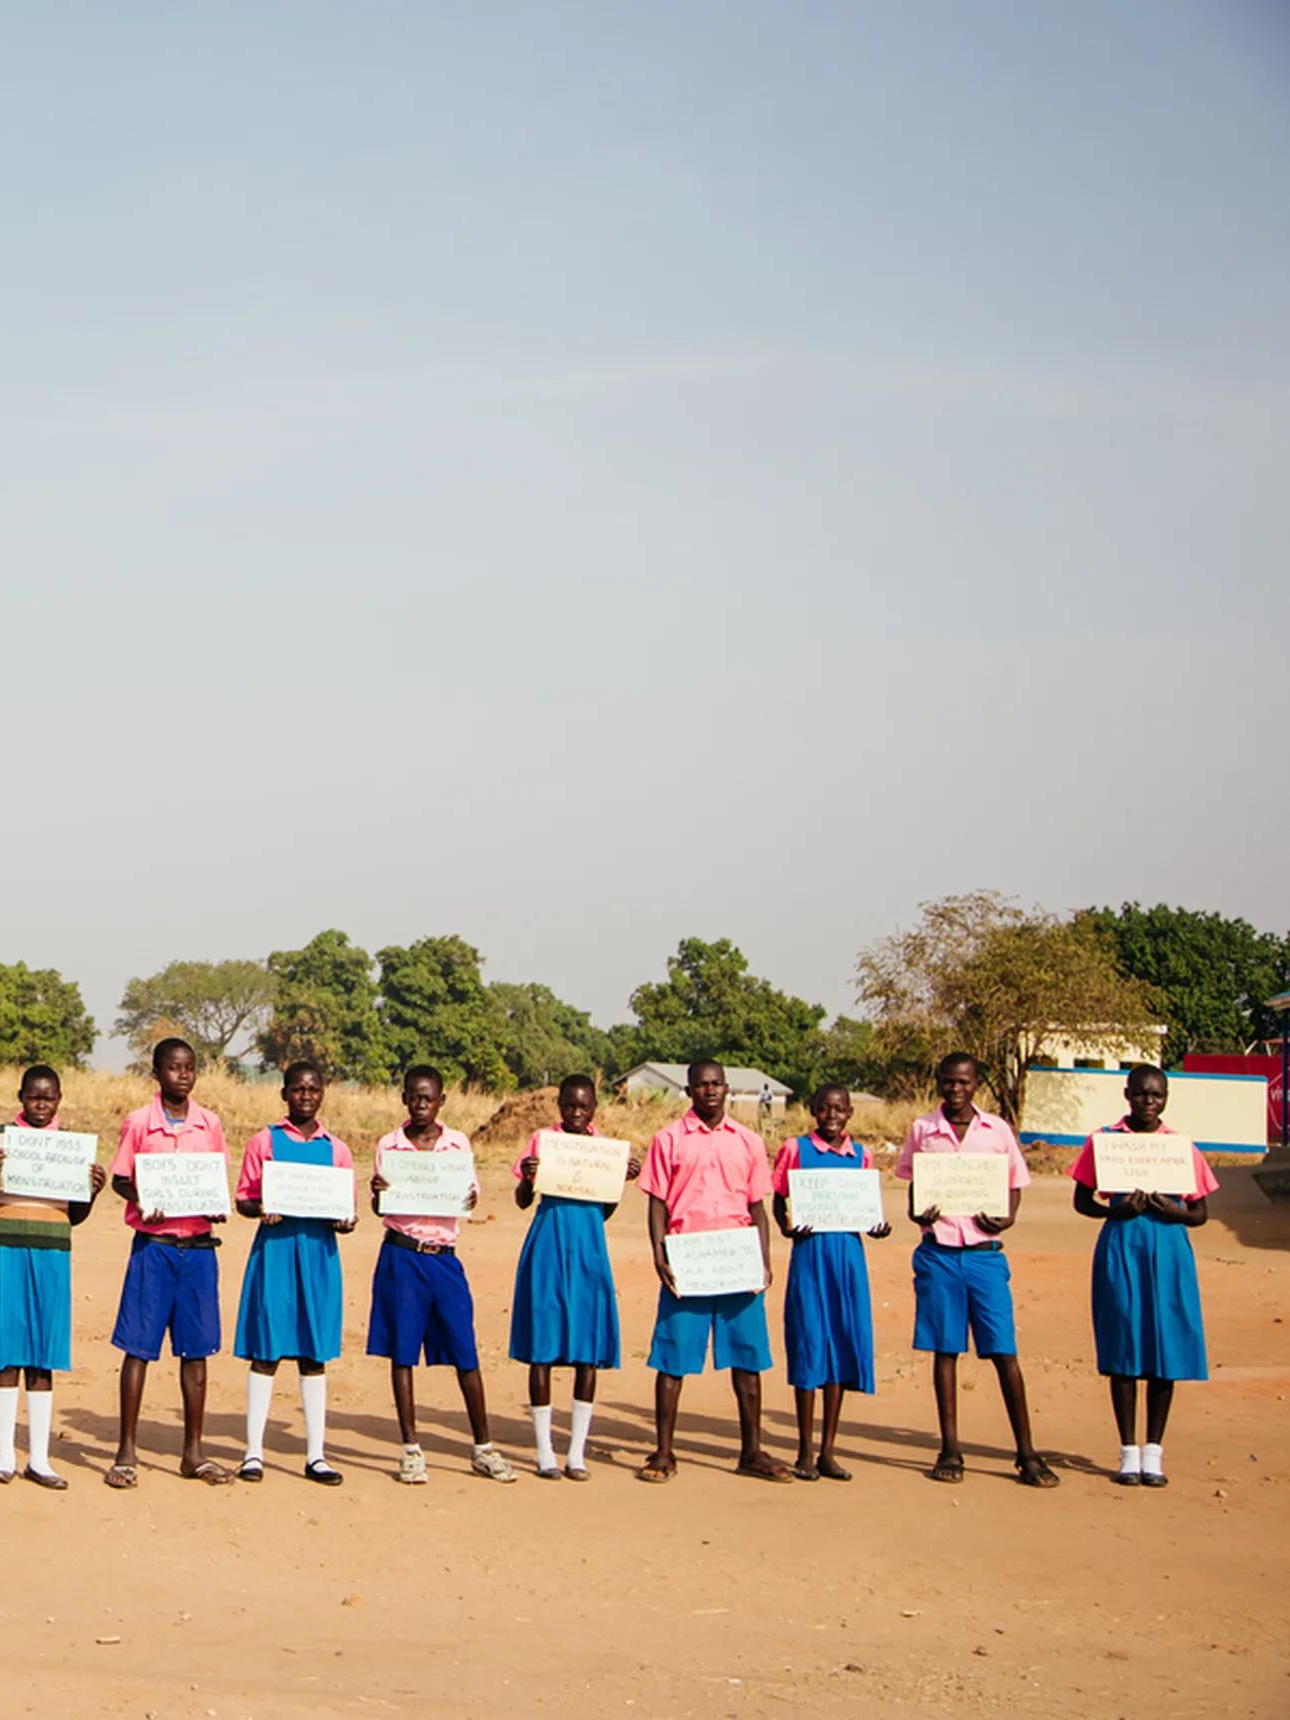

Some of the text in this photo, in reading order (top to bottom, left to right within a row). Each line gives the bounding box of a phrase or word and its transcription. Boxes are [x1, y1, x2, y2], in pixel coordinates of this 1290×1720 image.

[7, 1134, 11, 1145] I
[1111, 1139, 1147, 1152] WASH
[1150, 1142, 1166, 1153] MY
[31, 1163, 44, 1174] OF
[142, 1159, 178, 1172] BOYS
